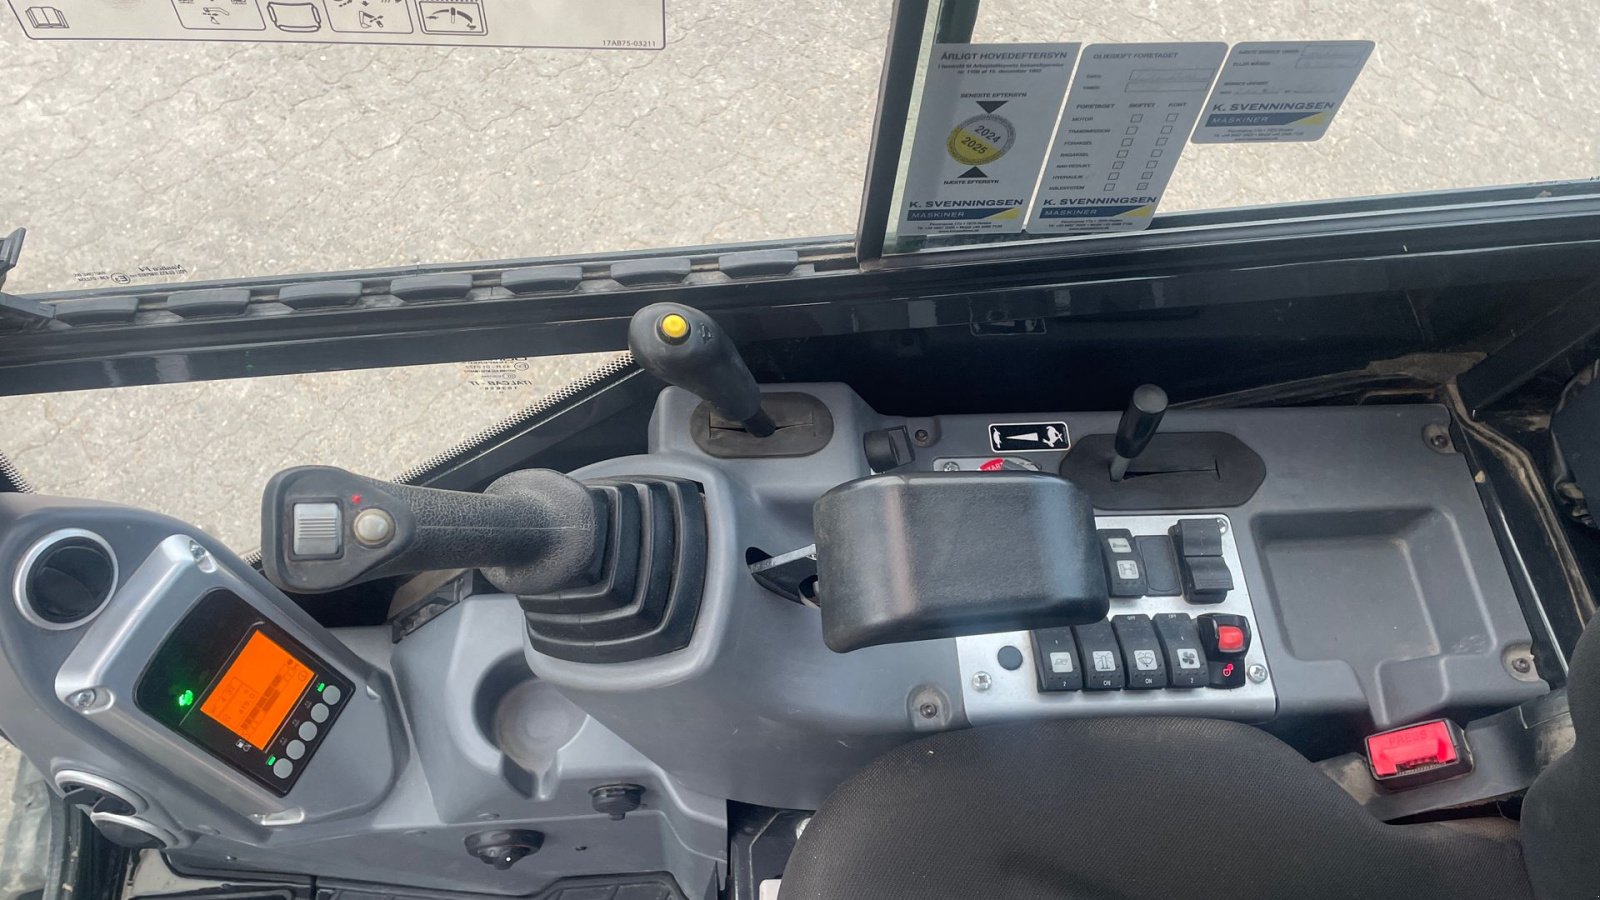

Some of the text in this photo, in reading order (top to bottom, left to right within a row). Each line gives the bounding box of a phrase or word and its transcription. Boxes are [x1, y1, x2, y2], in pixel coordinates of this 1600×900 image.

[602, 39, 656, 47] 17AB75-03211
[940, 51, 1068, 60] ÅRLIGT HOVEDEFTERSYN
[1212, 102, 1335, 111] K. SVENNINGSEN
[974, 125, 1001, 143] 2024
[961, 136, 988, 154] 2025
[925, 199, 1024, 208] SVENNINGSEN
[1059, 196, 1157, 205] SVENNINGSEN
[1389, 730, 1427, 745] PRESS
